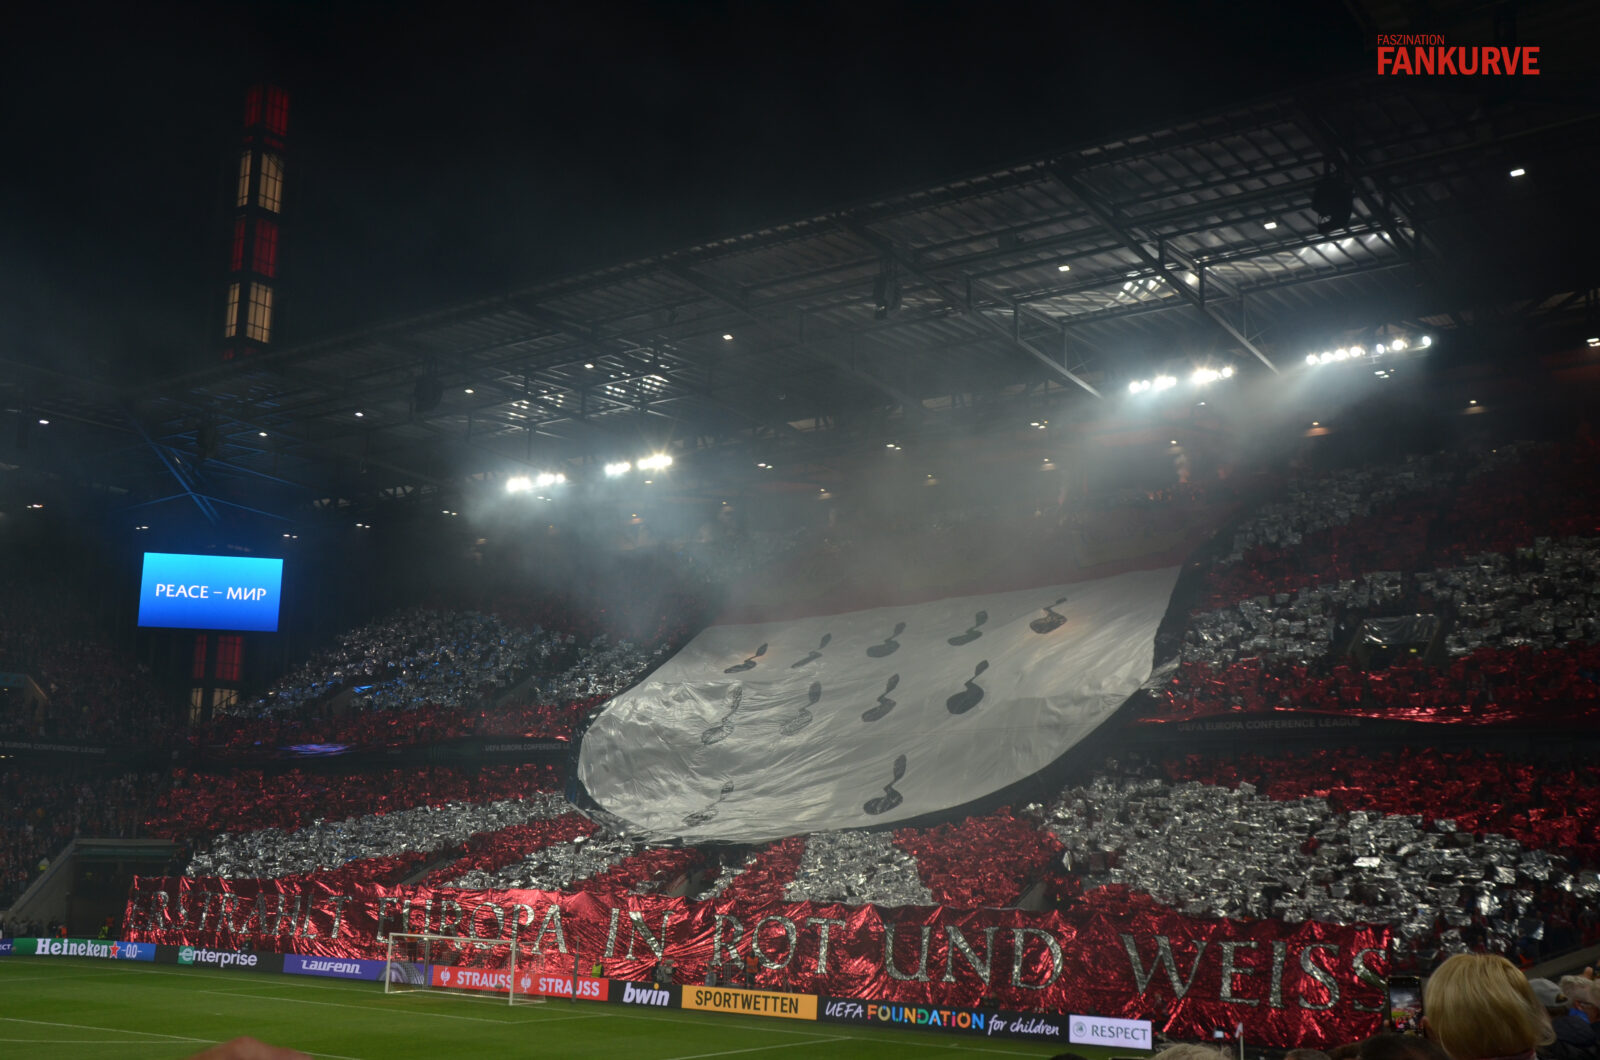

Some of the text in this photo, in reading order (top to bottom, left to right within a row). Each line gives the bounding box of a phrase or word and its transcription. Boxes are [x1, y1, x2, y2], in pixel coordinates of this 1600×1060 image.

[155, 583, 209, 598] PEACE
[226, 586, 267, 601] МИР
[1206, 721, 1244, 731] EUROPA
[1246, 719, 1316, 730] CONFERENCE
[1319, 717, 1360, 728] LEAGUE
[35, 938, 109, 959] Heineken
[179, 947, 258, 968] enterprise
[376, 897, 568, 955] EUROPA
[604, 907, 676, 962] IN
[714, 913, 847, 975] ROT
[884, 922, 1064, 990] UND
[1119, 933, 1388, 1013] WEISS
[457, 970, 512, 989] STRAUSS
[538, 977, 601, 996] STRAUSS
[622, 981, 670, 1007] bwin
[695, 989, 799, 1014] SPORTWETTEN
[825, 1000, 1060, 1037] UEFA FOUNDATION for children
[1090, 1024, 1150, 1042] RESPECT
